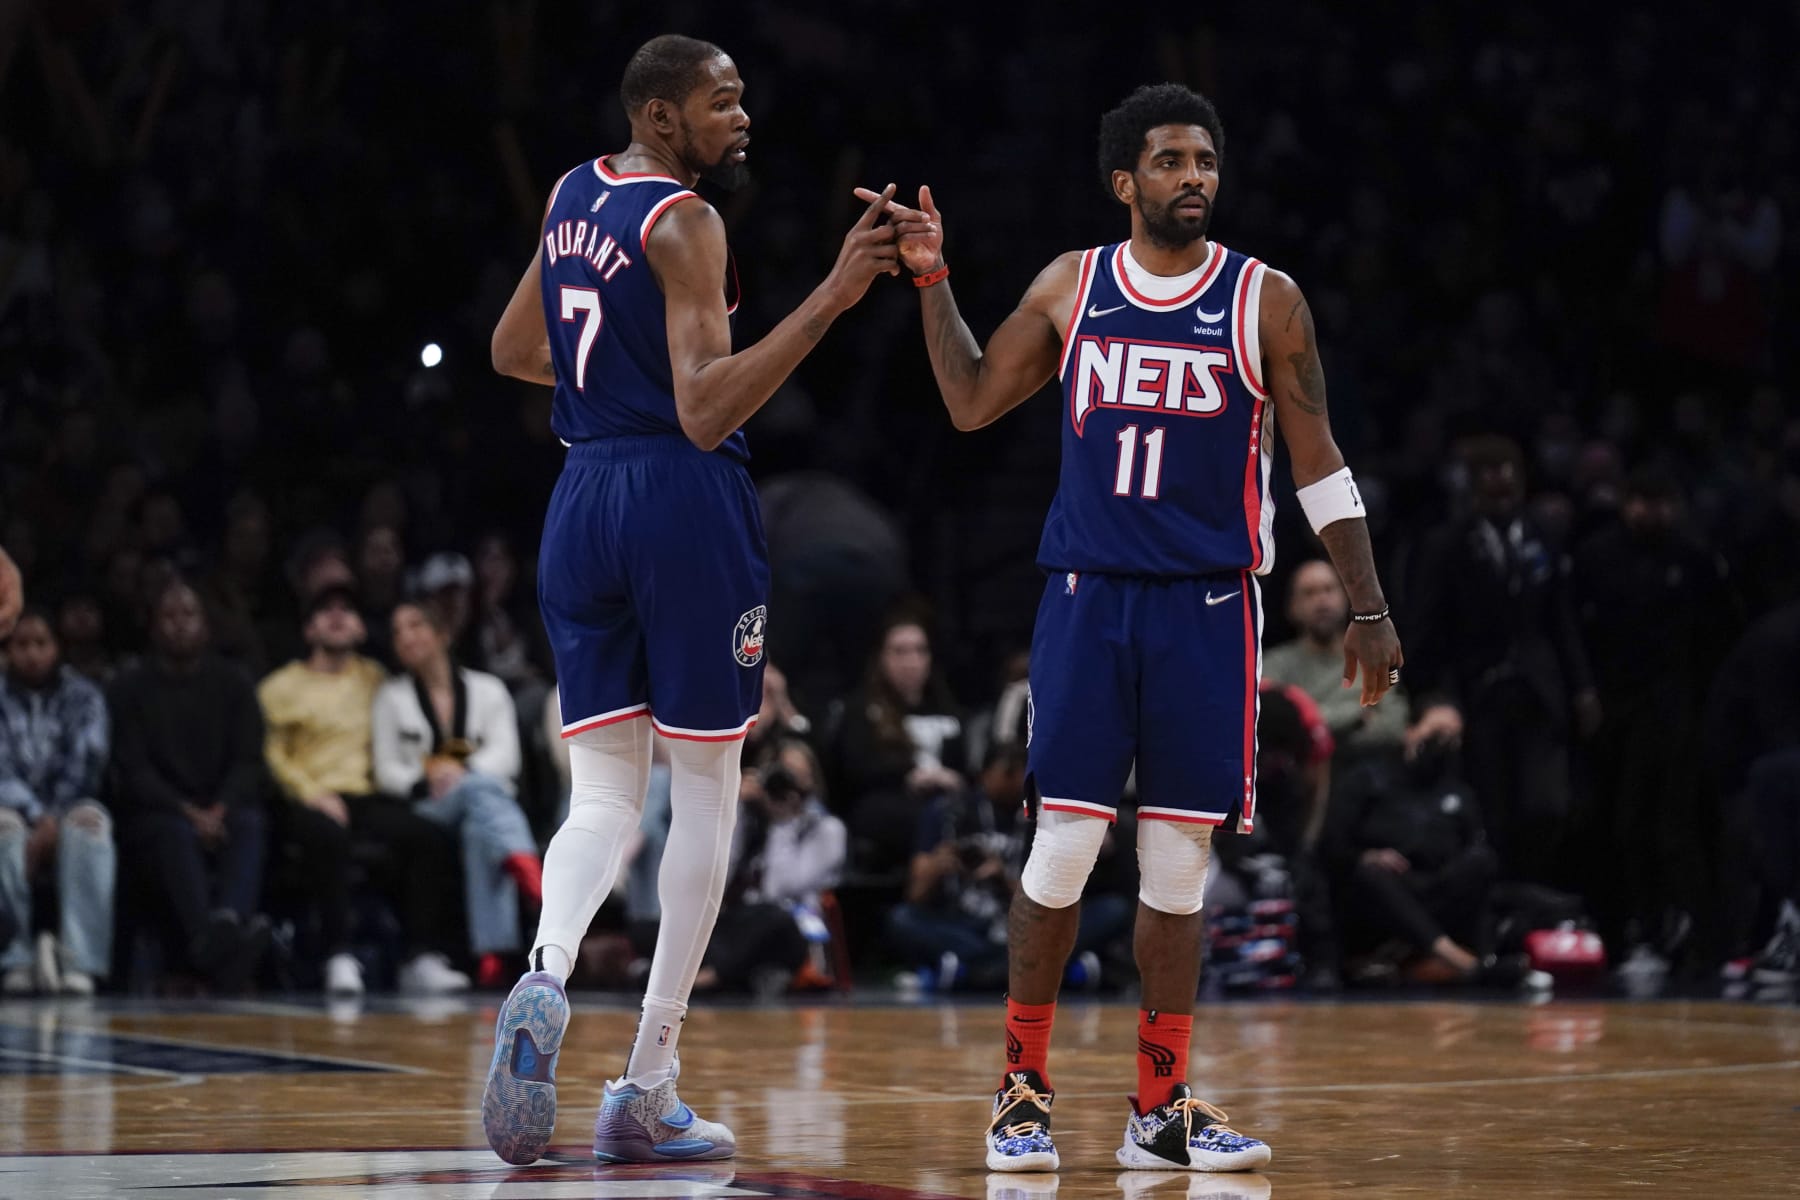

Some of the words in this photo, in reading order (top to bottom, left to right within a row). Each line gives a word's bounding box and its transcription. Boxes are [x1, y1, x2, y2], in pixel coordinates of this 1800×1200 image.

[545, 218, 632, 283] DURANT
[559, 284, 604, 392] 7
[1193, 325, 1223, 337] Webull
[1071, 335, 1233, 438] NETS
[1113, 424, 1166, 499] 11
